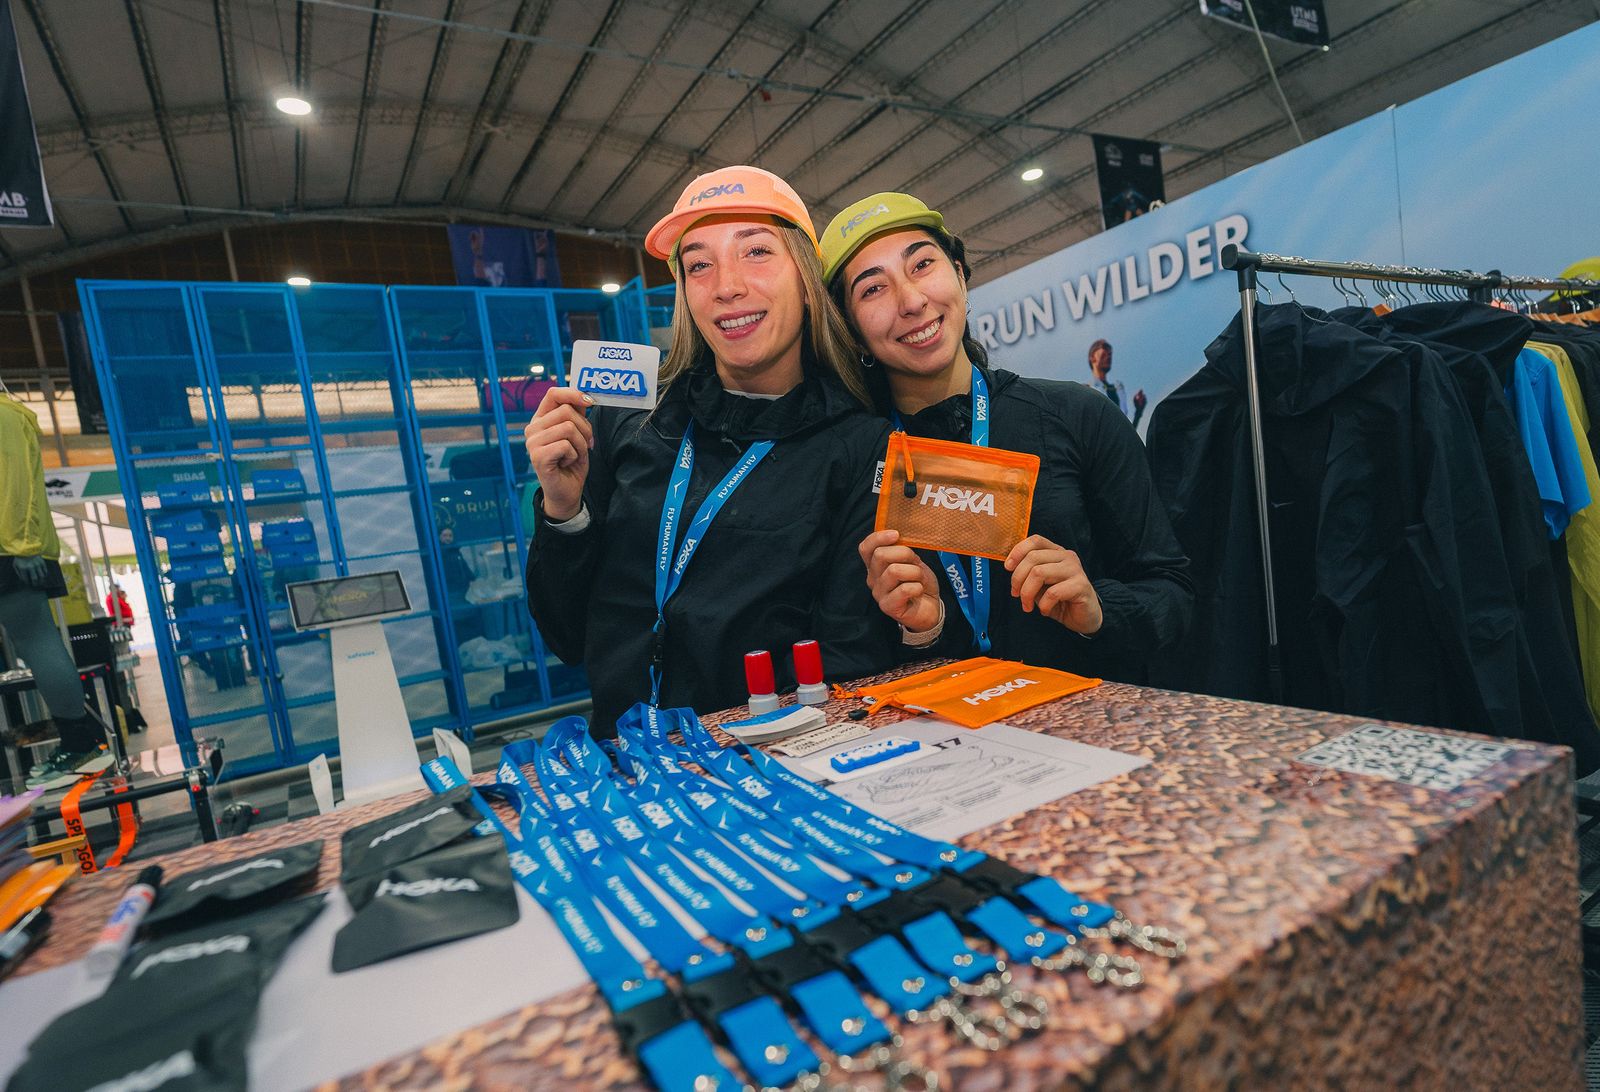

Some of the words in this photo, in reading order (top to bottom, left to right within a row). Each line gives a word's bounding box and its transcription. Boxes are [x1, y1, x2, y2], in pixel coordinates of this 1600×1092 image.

[690, 182, 746, 206] HOKA
[840, 203, 890, 239] HOKA
[976, 289, 1055, 350] RUN
[1063, 214, 1252, 320] WILDER
[599, 347, 632, 360] HOKA
[579, 369, 642, 393] HOKA
[976, 394, 987, 421] HOKA
[718, 487, 729, 499] FLY
[727, 465, 749, 490] HUMAN
[746, 454, 758, 468] FLY
[667, 507, 675, 521] FLY
[919, 484, 997, 516] HOKA
[662, 521, 673, 556] HUMAN
[659, 556, 667, 571] FLY
[674, 538, 697, 575] HOKA
[946, 563, 969, 599] HOKA
[976, 579, 984, 594] FLY
[962, 678, 1041, 706] HOKA
